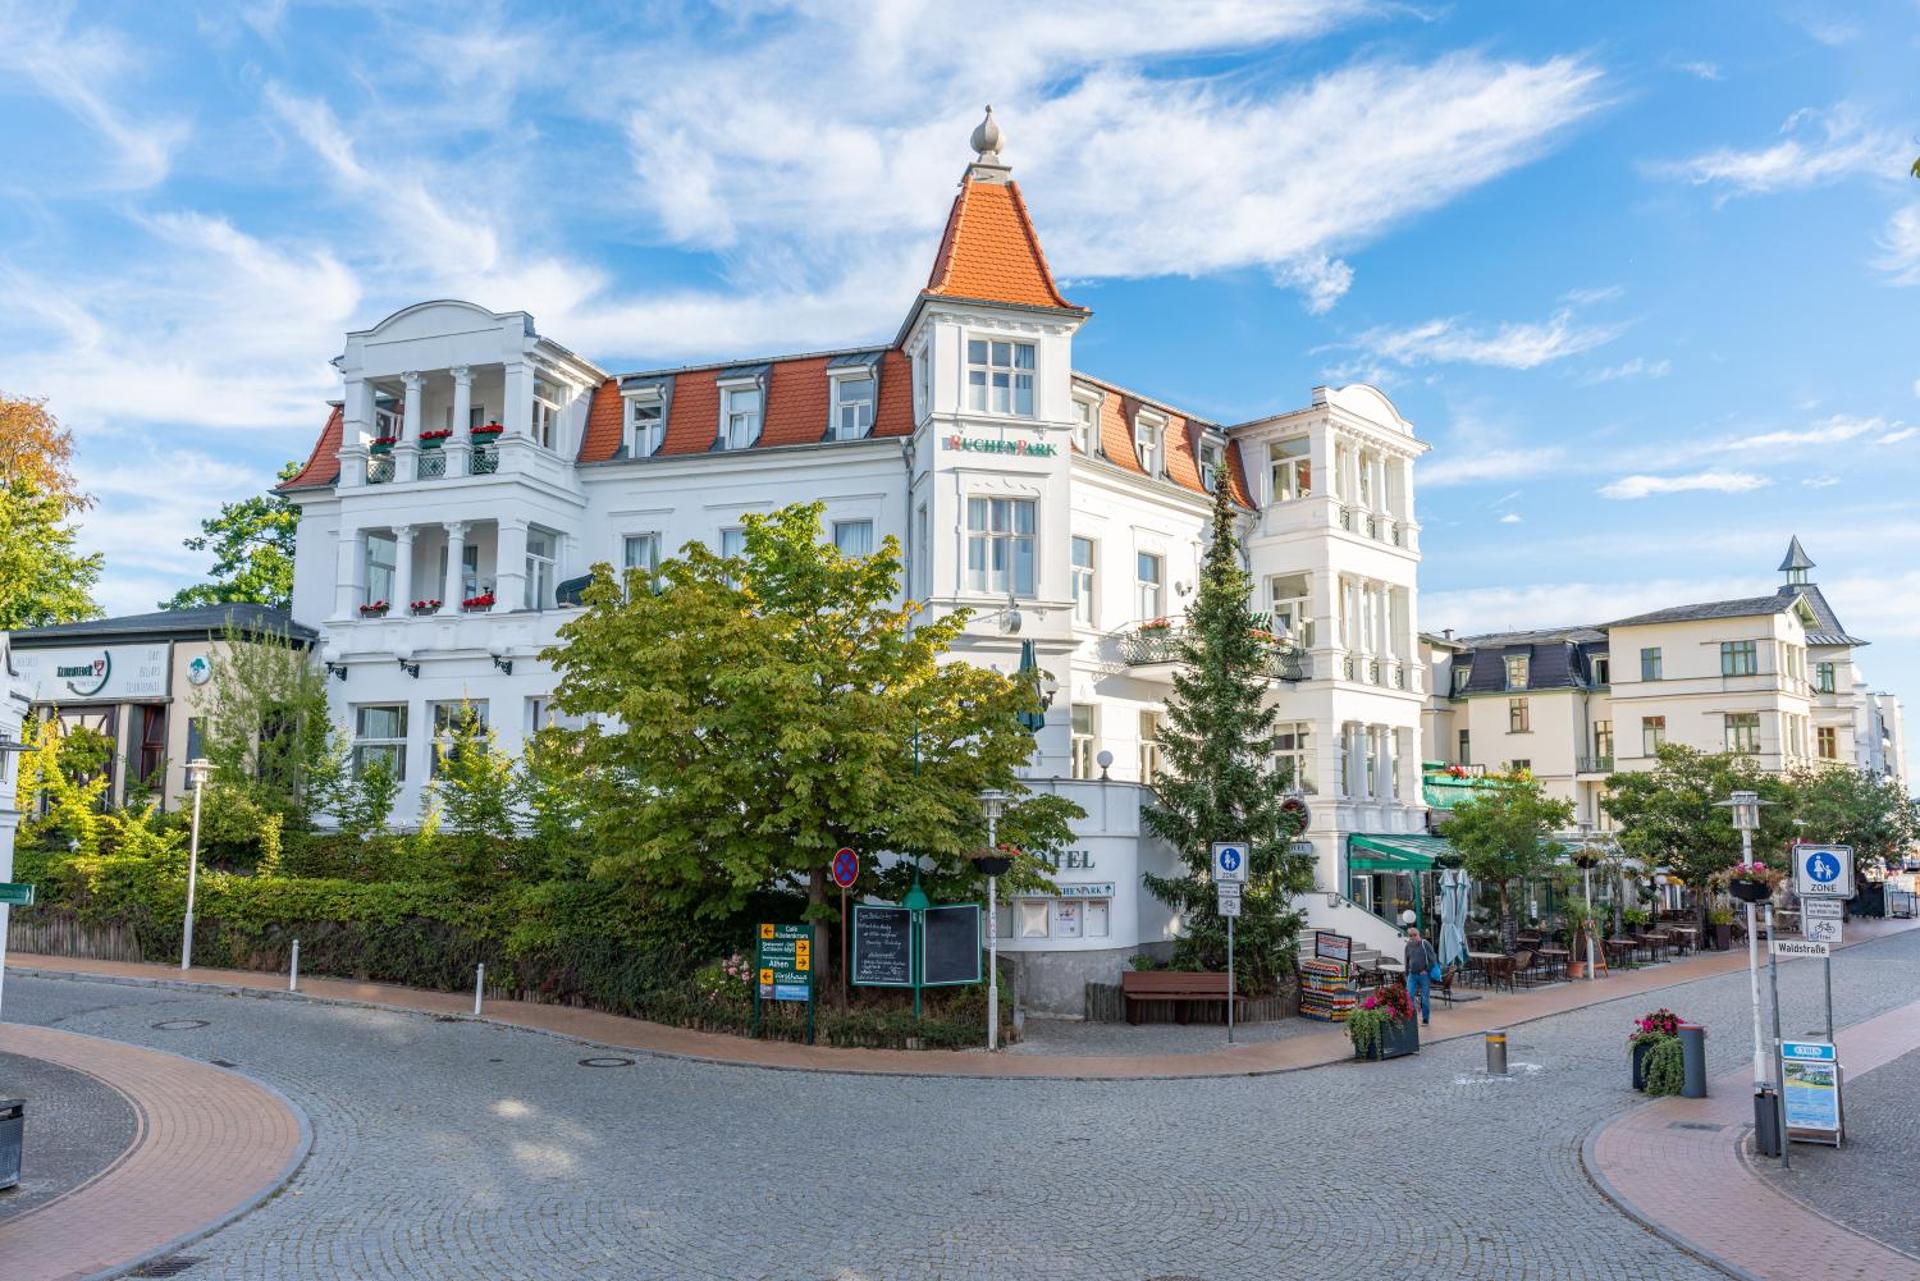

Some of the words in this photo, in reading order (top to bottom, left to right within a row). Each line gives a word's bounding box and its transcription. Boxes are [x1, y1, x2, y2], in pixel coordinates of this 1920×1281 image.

[1032, 850, 1096, 869] OTEL
[1810, 884, 1837, 893] ZONE
[1779, 943, 1826, 954] Waldstraße
